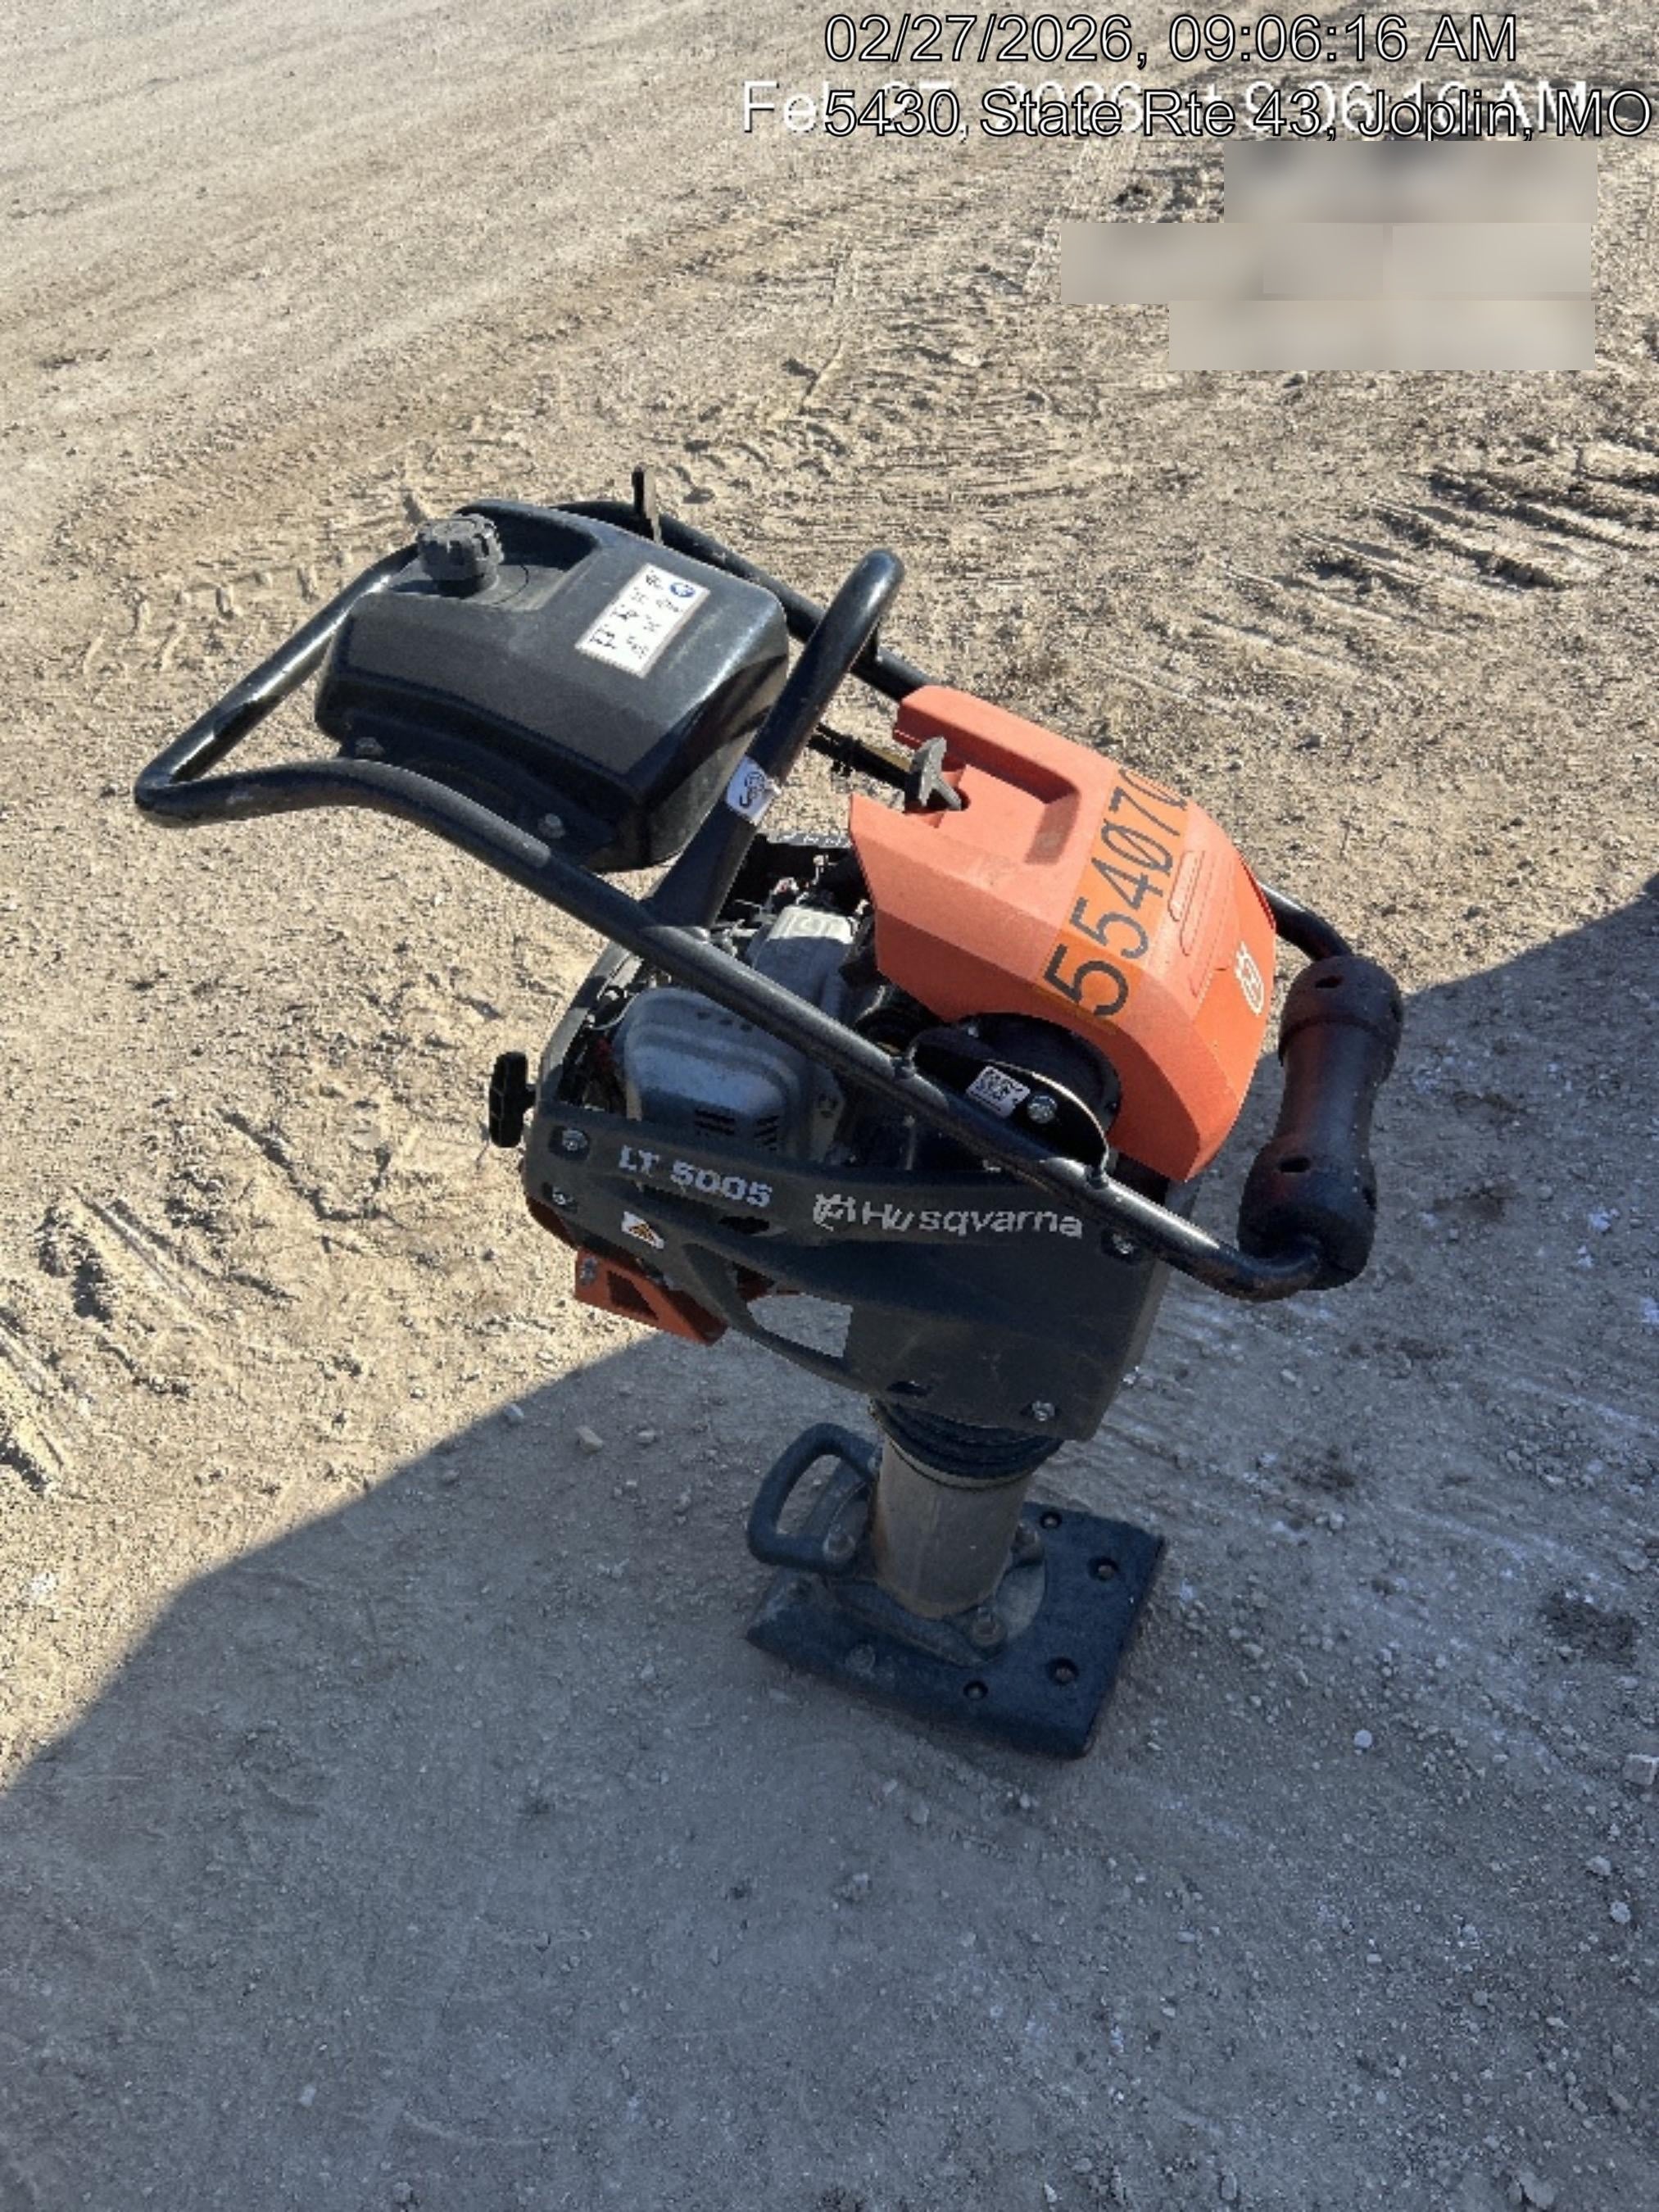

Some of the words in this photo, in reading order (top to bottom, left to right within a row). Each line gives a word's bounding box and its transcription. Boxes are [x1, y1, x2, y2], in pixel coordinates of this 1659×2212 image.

[619, 1145, 660, 1178] LT
[670, 1159, 773, 1208] 5005
[862, 1201, 1083, 1239] Husqvarna
